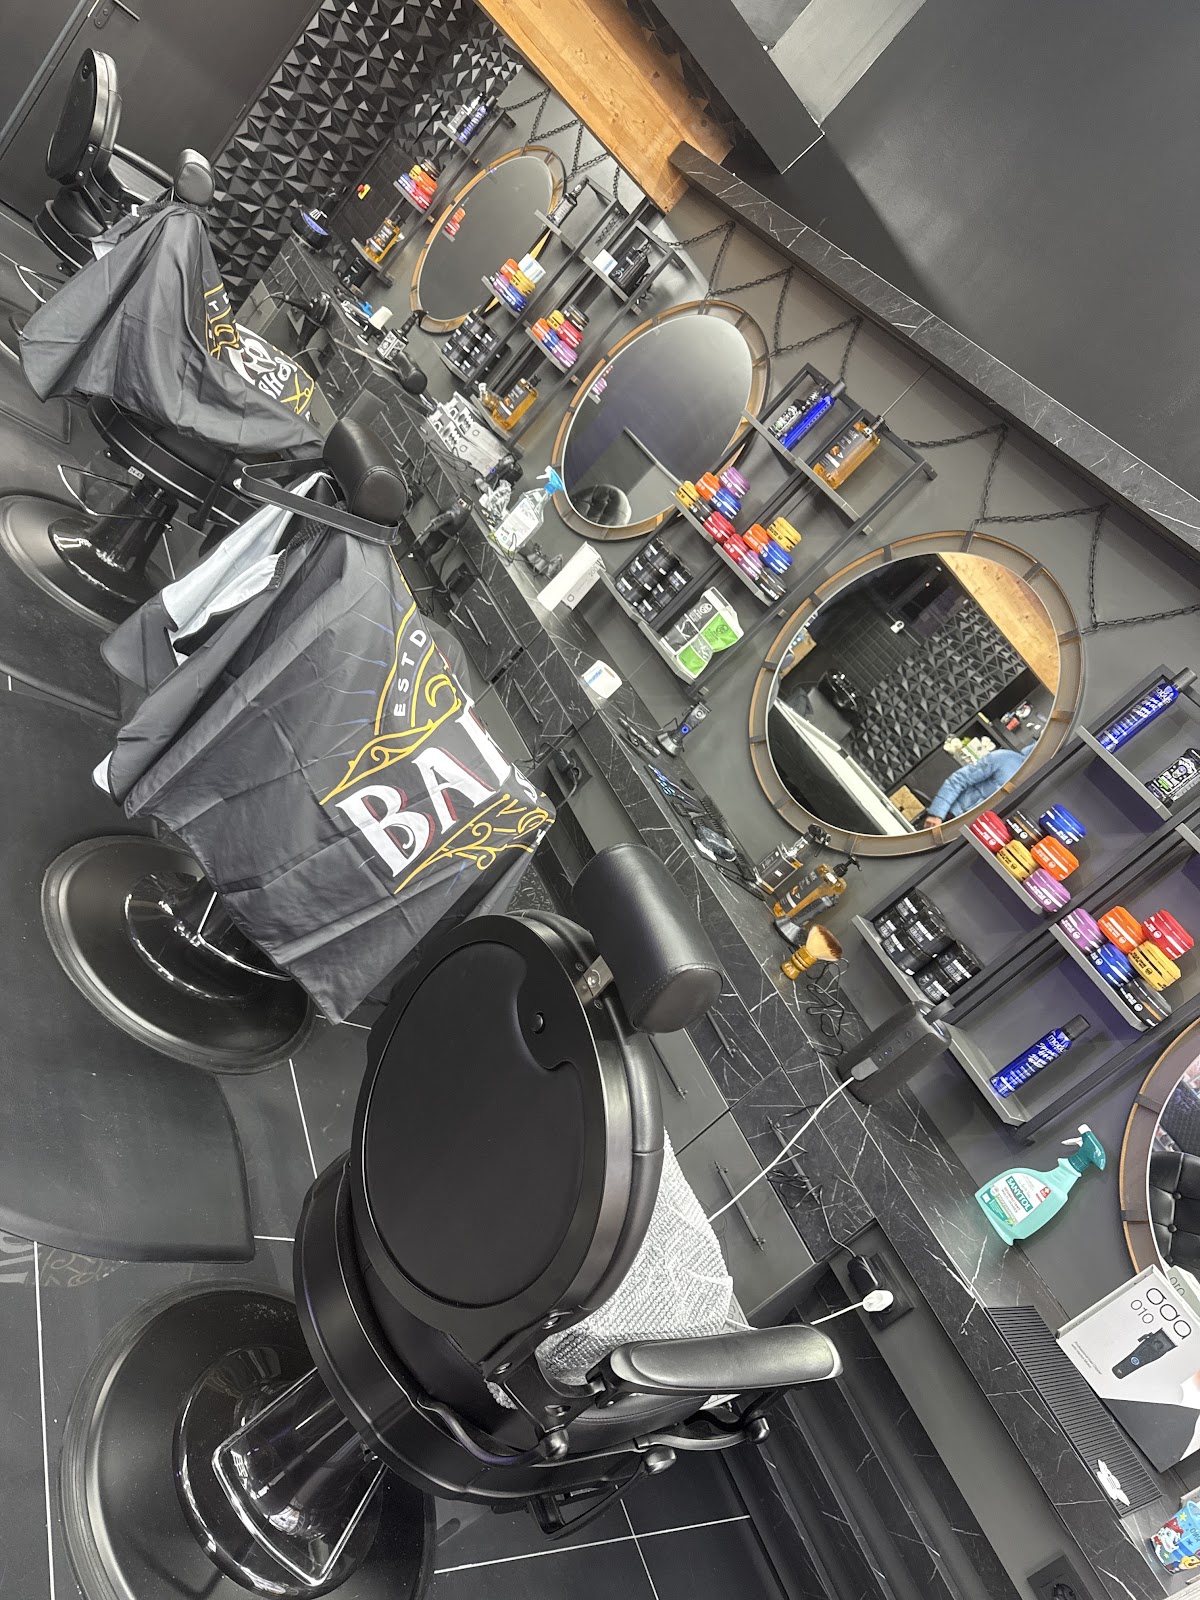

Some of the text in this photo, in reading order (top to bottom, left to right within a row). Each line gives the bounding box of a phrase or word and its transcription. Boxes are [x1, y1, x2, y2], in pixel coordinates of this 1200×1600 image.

[394, 628, 428, 717] ESTD
[1006, 1176, 1032, 1211] SANYTOL
[1131, 1299, 1155, 1324] 010
